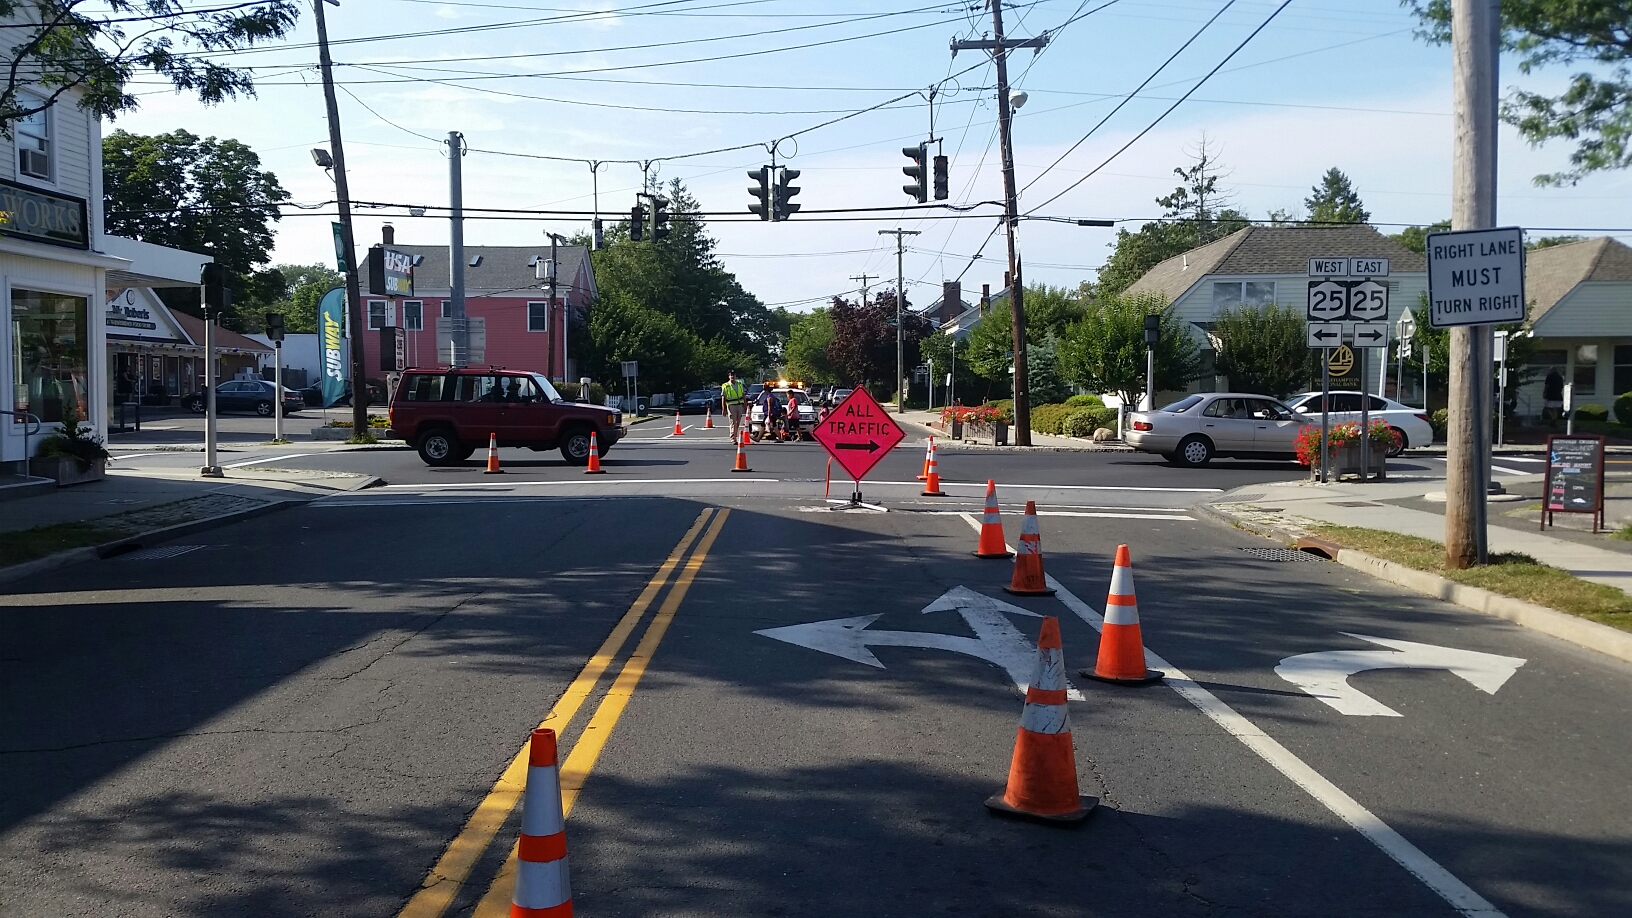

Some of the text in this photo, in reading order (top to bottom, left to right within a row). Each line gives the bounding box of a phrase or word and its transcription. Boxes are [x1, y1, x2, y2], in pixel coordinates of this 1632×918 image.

[3, 194, 78, 235] WORKS
[1434, 240, 1516, 260] RIGHT LANE
[384, 250, 414, 275] USA
[1315, 261, 1343, 273] WEST
[1356, 261, 1382, 273] EAST
[385, 275, 411, 293] SUBWAY
[1452, 267, 1502, 287] MUST
[1312, 290, 1343, 312] 25
[1353, 290, 1384, 312] 25
[1436, 294, 1519, 315] TURN RIGHT
[324, 311, 343, 382] SUBWAY
[845, 404, 873, 418] ALL
[829, 422, 890, 436] TRAFFIC
